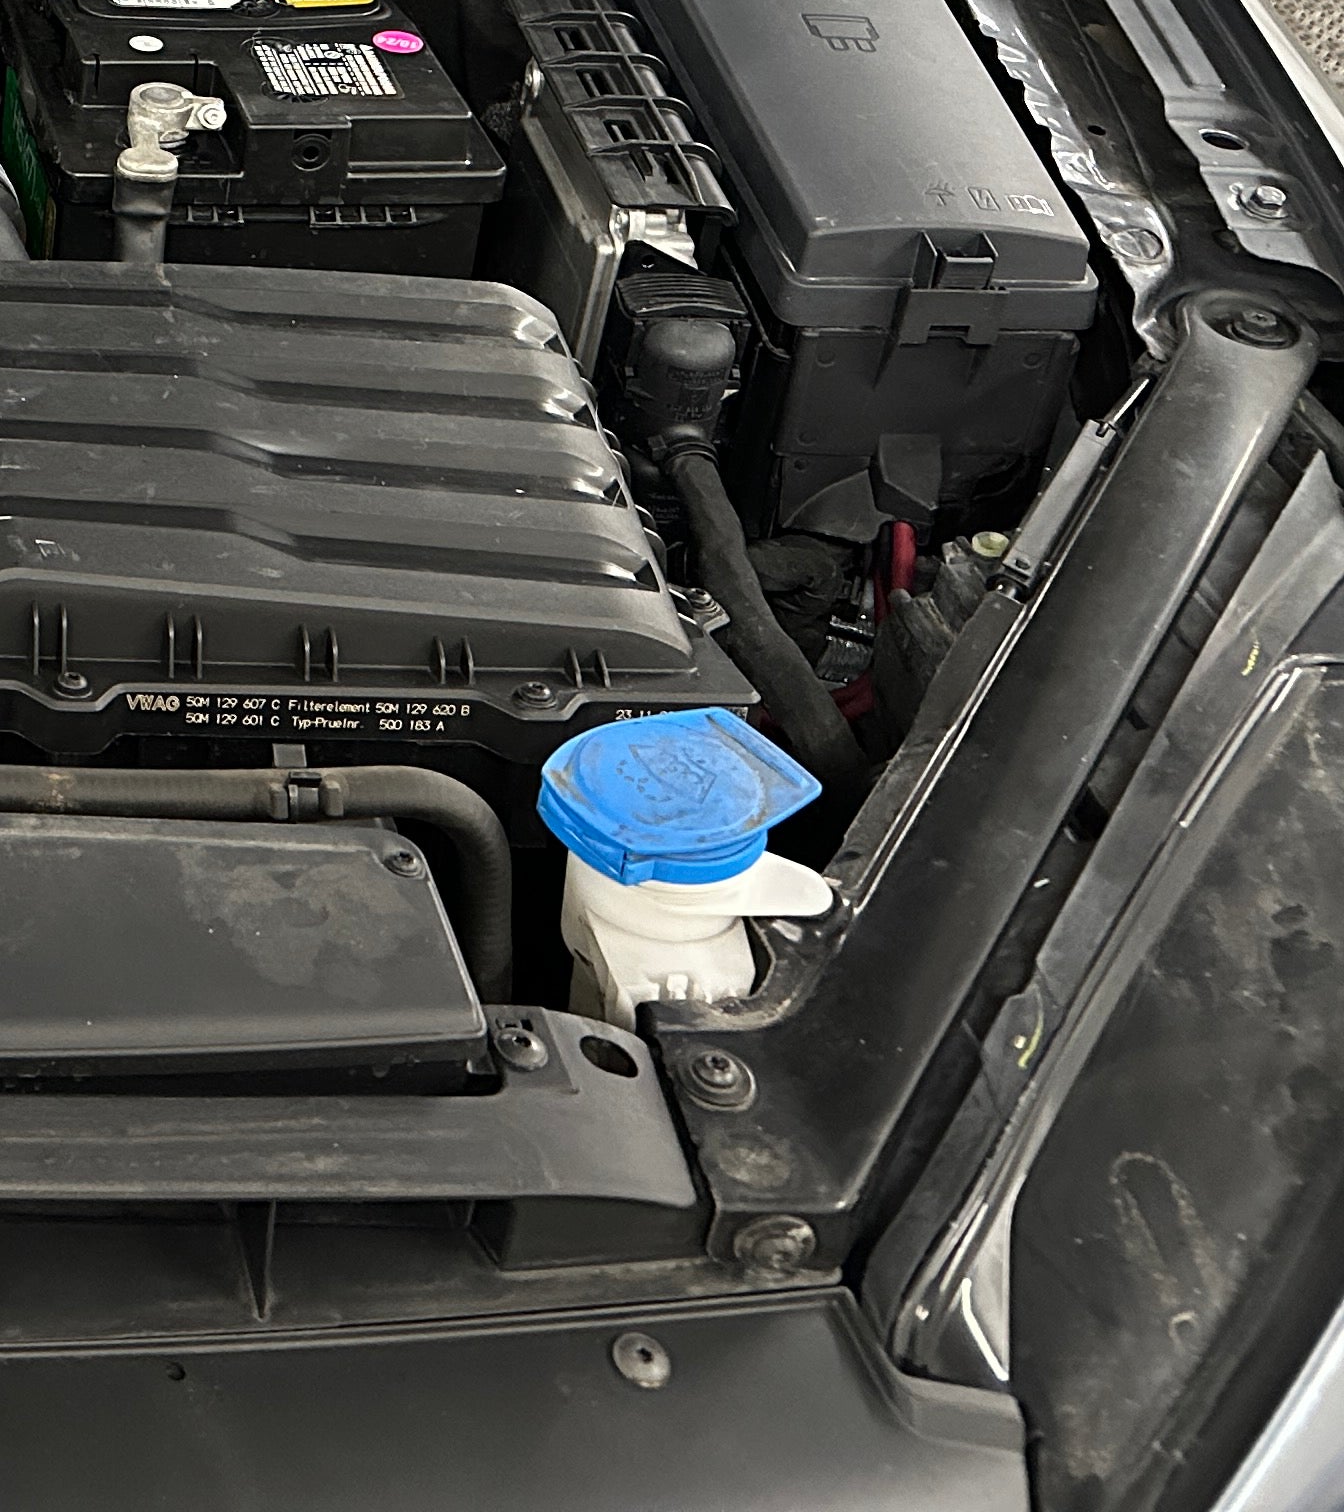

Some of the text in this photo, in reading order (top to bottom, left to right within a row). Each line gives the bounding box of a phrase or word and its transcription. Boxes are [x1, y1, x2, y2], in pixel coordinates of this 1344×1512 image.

[126, 694, 470, 716] VWAG 5QM 129 607 C Filterelement 5QM 129 620 B
[615, 709, 633, 721] 23
[186, 712, 210, 724] 5QM
[216, 714, 238, 725] 129
[242, 715, 262, 726] 601
[270, 716, 280, 726] C
[410, 720, 431, 731] 183
[436, 721, 445, 732] A
